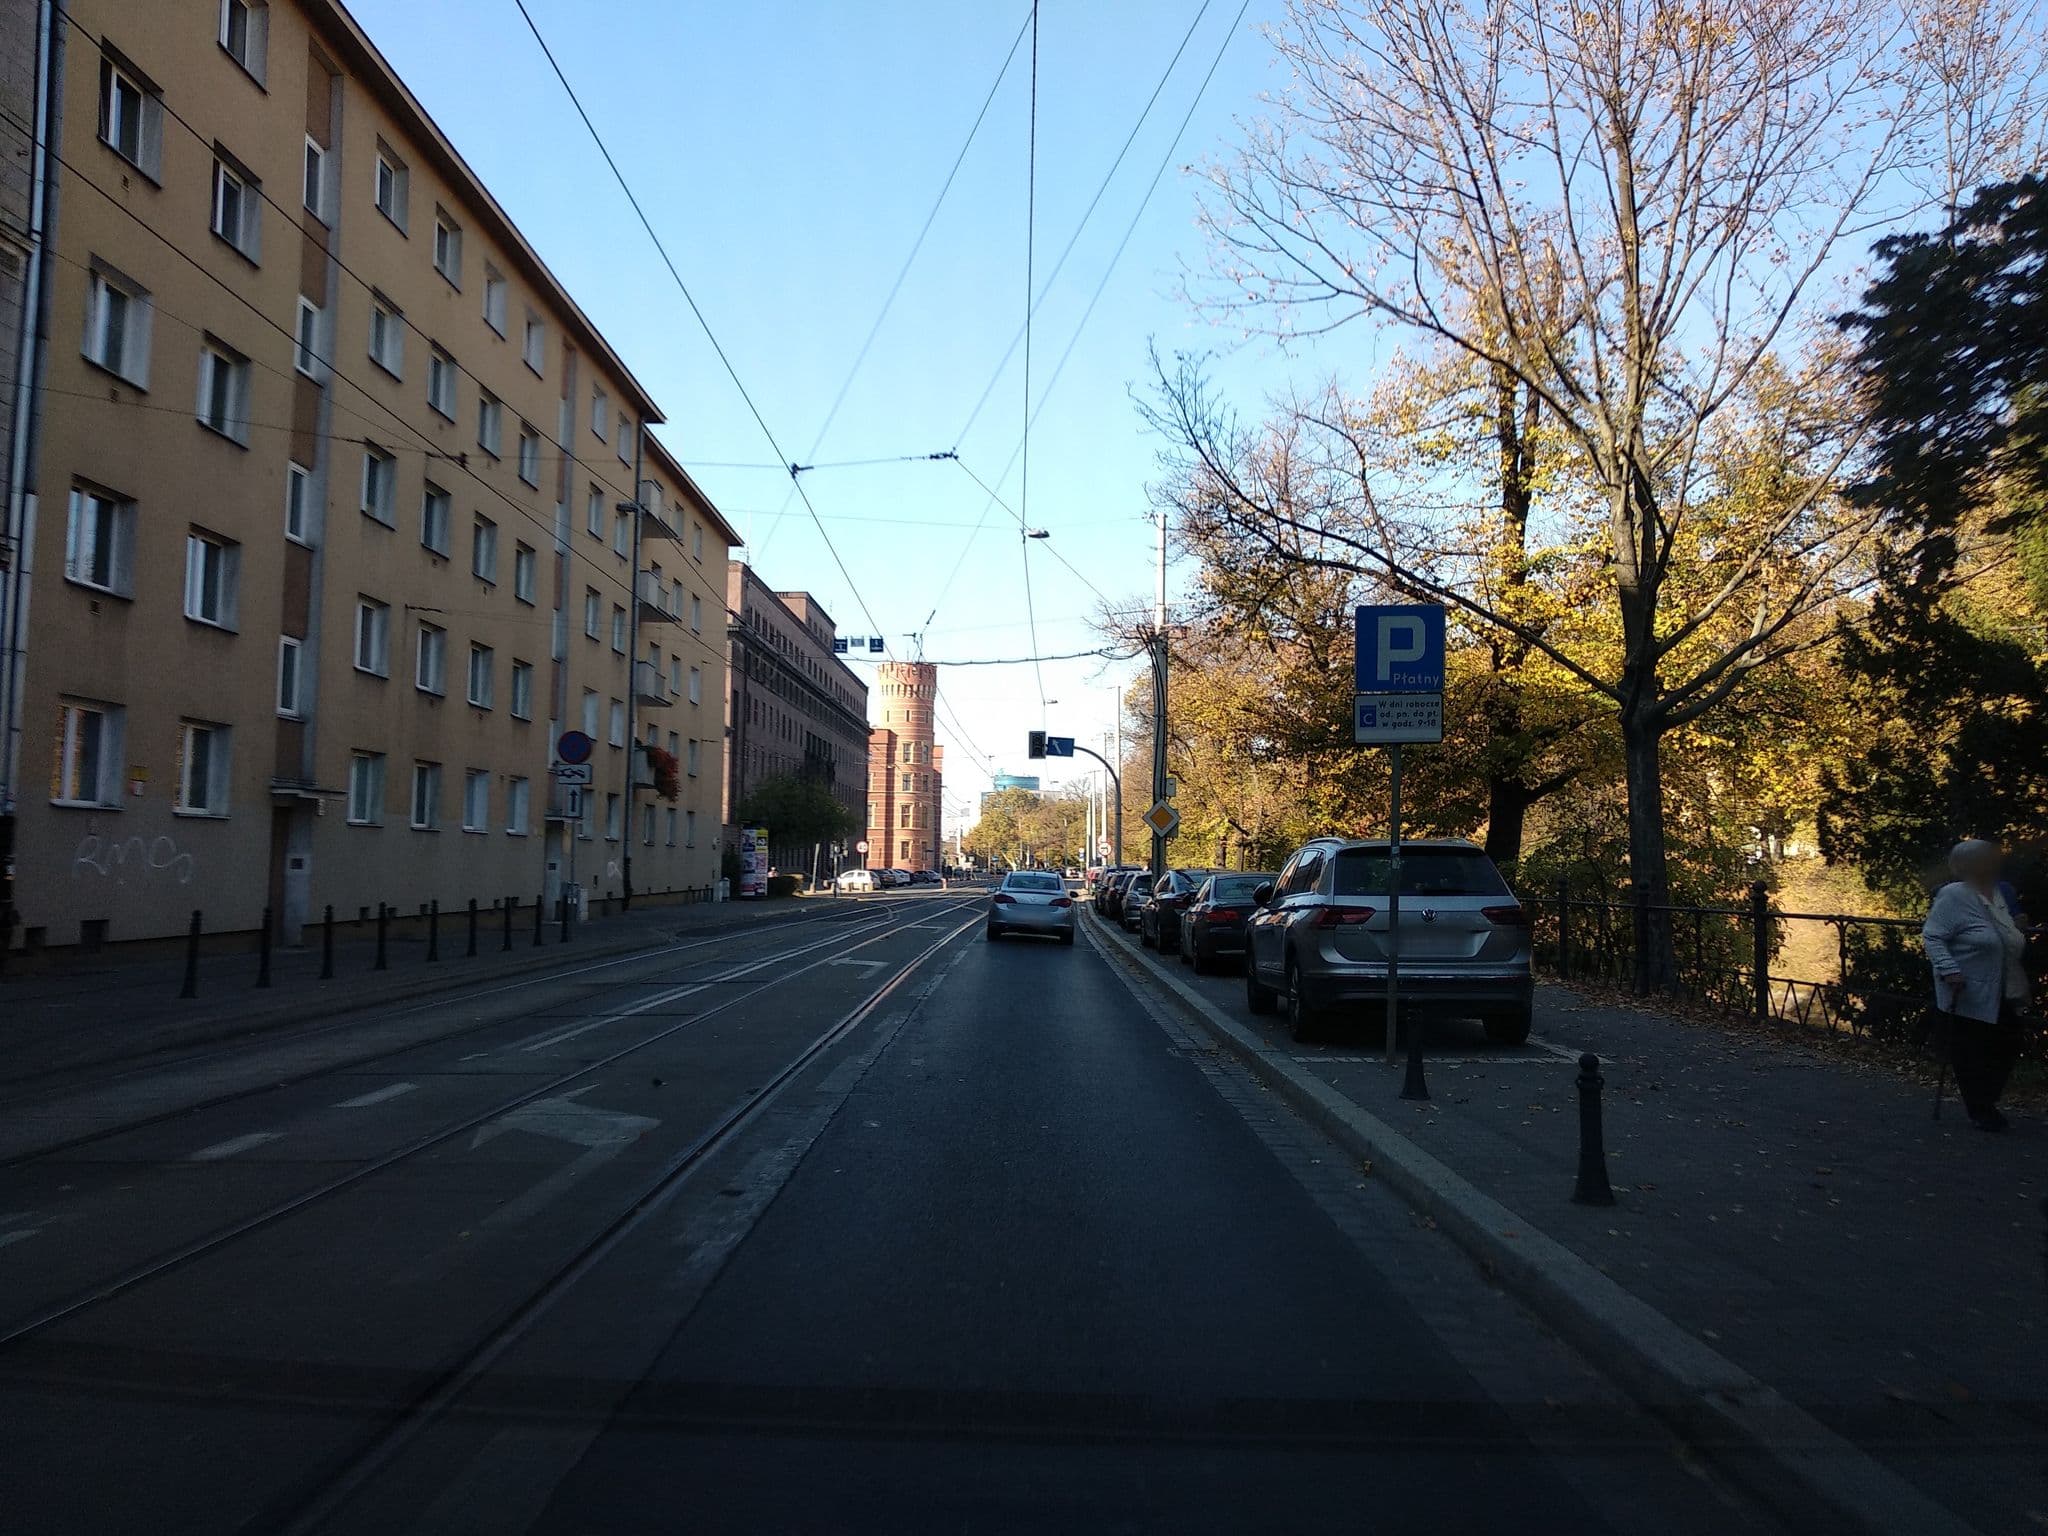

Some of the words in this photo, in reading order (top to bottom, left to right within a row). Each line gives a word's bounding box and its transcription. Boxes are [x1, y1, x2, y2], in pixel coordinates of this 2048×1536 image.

[1377, 615, 1426, 681] P
[1393, 672, 1440, 688] Płatny
[1389, 700, 1403, 708] dni
[1405, 700, 1440, 708] robocze
[1363, 713, 1374, 725] C
[1417, 719, 1437, 728] 9-18
